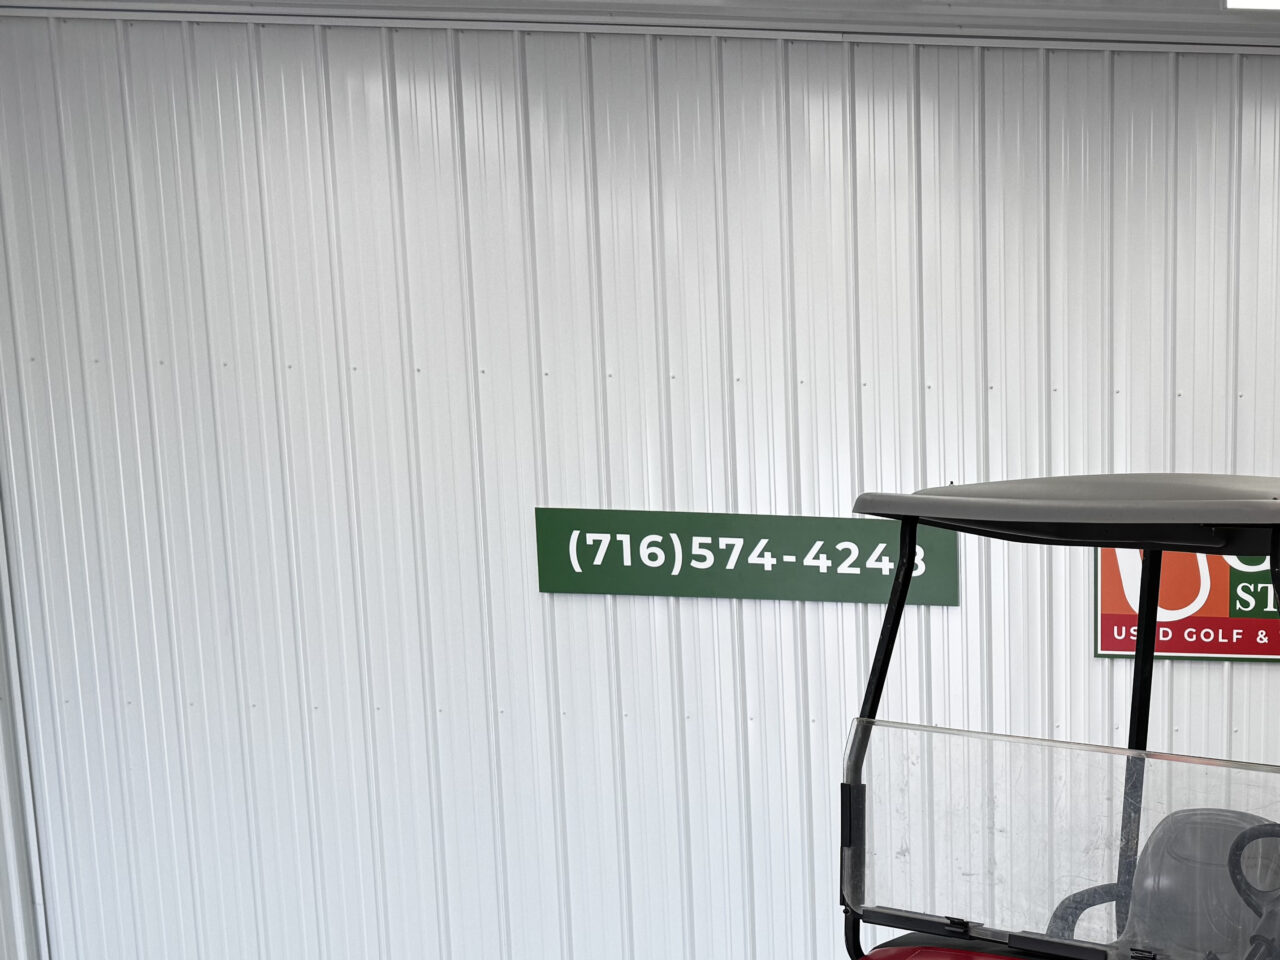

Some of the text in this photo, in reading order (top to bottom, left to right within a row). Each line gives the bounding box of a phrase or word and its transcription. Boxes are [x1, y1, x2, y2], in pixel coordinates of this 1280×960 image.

[1113, 625, 1173, 641] USD
[1183, 627, 1243, 643] GOLF
[1256, 630, 1269, 644] &
